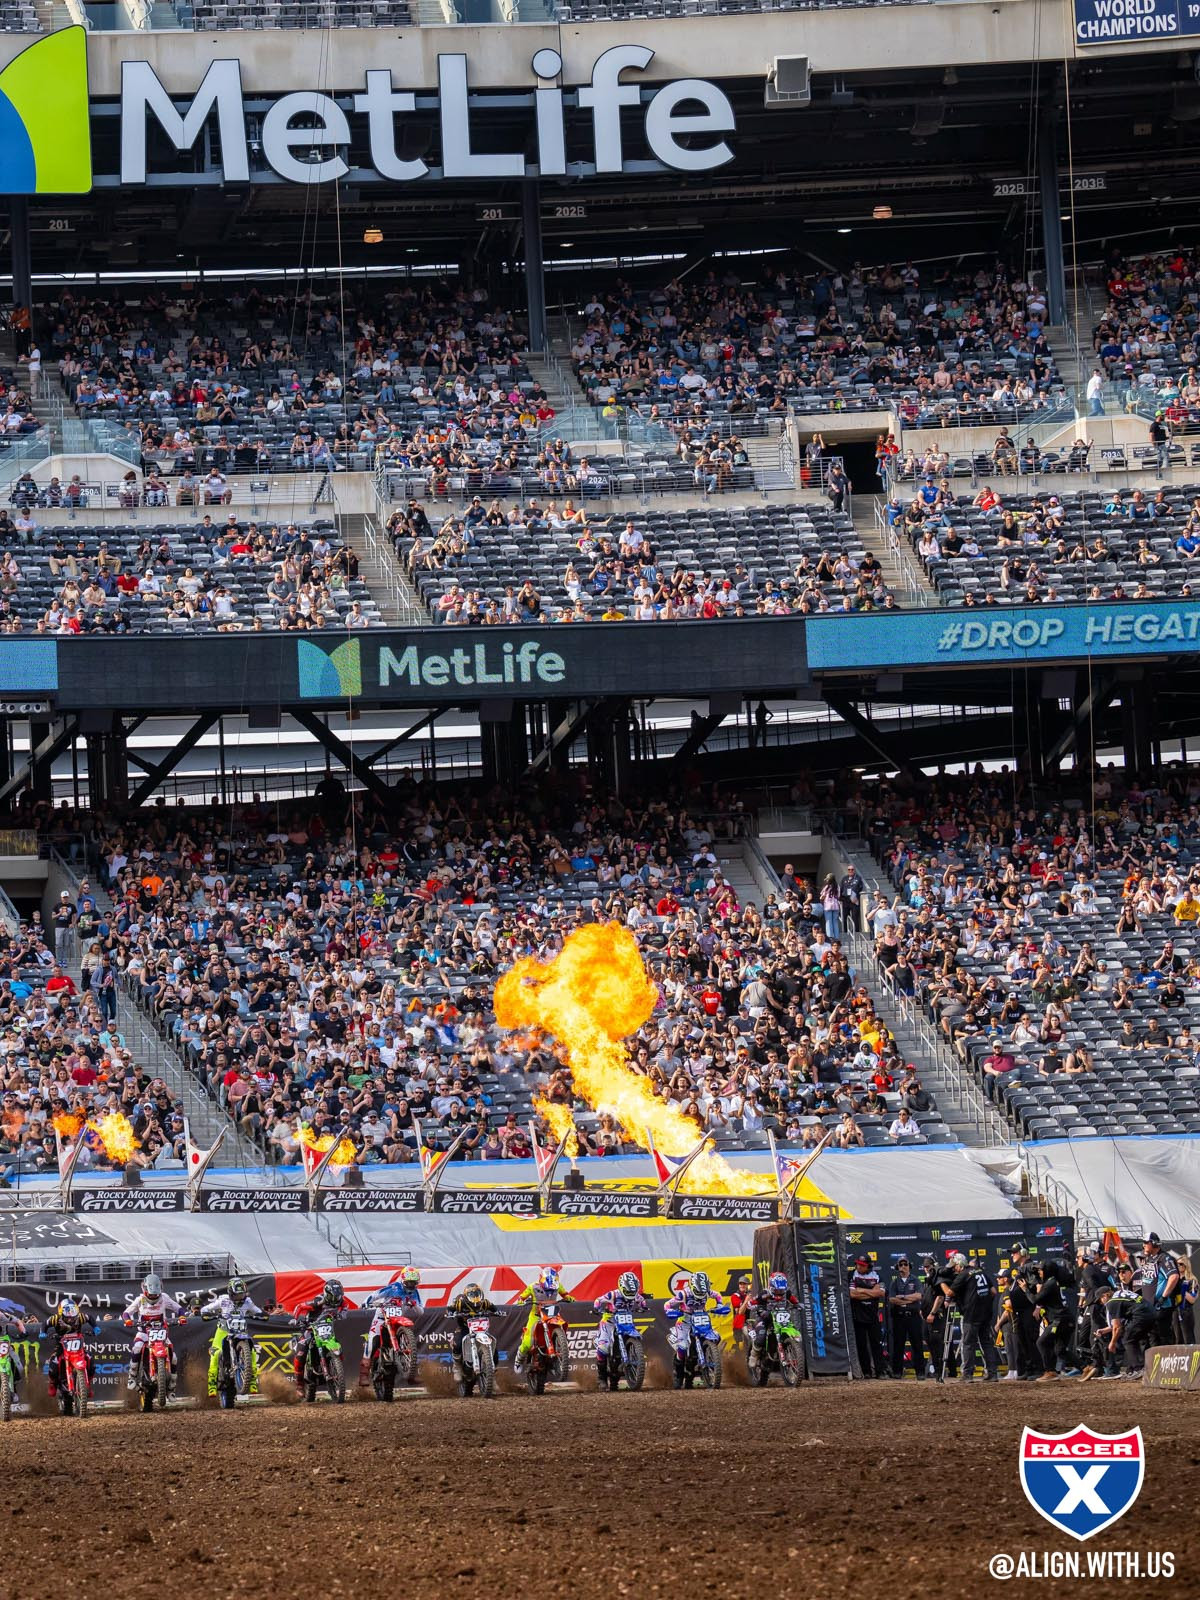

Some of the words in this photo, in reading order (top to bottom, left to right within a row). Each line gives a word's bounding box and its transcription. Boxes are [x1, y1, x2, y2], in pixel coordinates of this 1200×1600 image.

[1094, 0, 1156, 18] WORLD
[1076, 14, 1177, 39] CHAMPIONS
[118, 43, 738, 184] MetLife
[1074, 178, 1105, 189] 203B
[994, 184, 1026, 195] 202B
[482, 209, 503, 219] 201
[556, 206, 585, 217] 202B
[49, 219, 70, 229] 201
[588, 476, 608, 485] 202A
[80, 488, 100, 496] 250A
[937, 618, 1065, 651] #DROP
[378, 640, 566, 687] MetLife
[97, 1190, 126, 1199] ROCKY
[127, 1190, 176, 1199] MOUNTAIN
[223, 1190, 252, 1200] ROCKY
[252, 1191, 302, 1200] MOUNTAIN
[338, 1190, 367, 1199] ROCKY
[368, 1190, 417, 1199] MOUNTAIN
[456, 1192, 486, 1201] ROCKY
[486, 1193, 533, 1202] MOUNTAIN
[573, 1193, 602, 1203] ROCKY
[603, 1194, 650, 1204] MOUNTAIN
[695, 1197, 724, 1207] ROCKY
[724, 1199, 772, 1209] MOUNTAIN
[974, 1273, 988, 1288] 21
[124, 1287, 218, 1304] SRTS
[385, 1307, 403, 1317] 195
[544, 1305, 556, 1317] 1
[802, 1283, 814, 1338] CHAMPIONSHIP
[827, 1285, 840, 1336] MONSTER
[618, 1314, 633, 1324] 88
[693, 1315, 710, 1326] 92
[776, 1312, 791, 1322] 62
[317, 1326, 332, 1336] 192
[469, 1320, 489, 1331] 24
[148, 1329, 166, 1341] 59
[66, 1340, 81, 1351] 10
